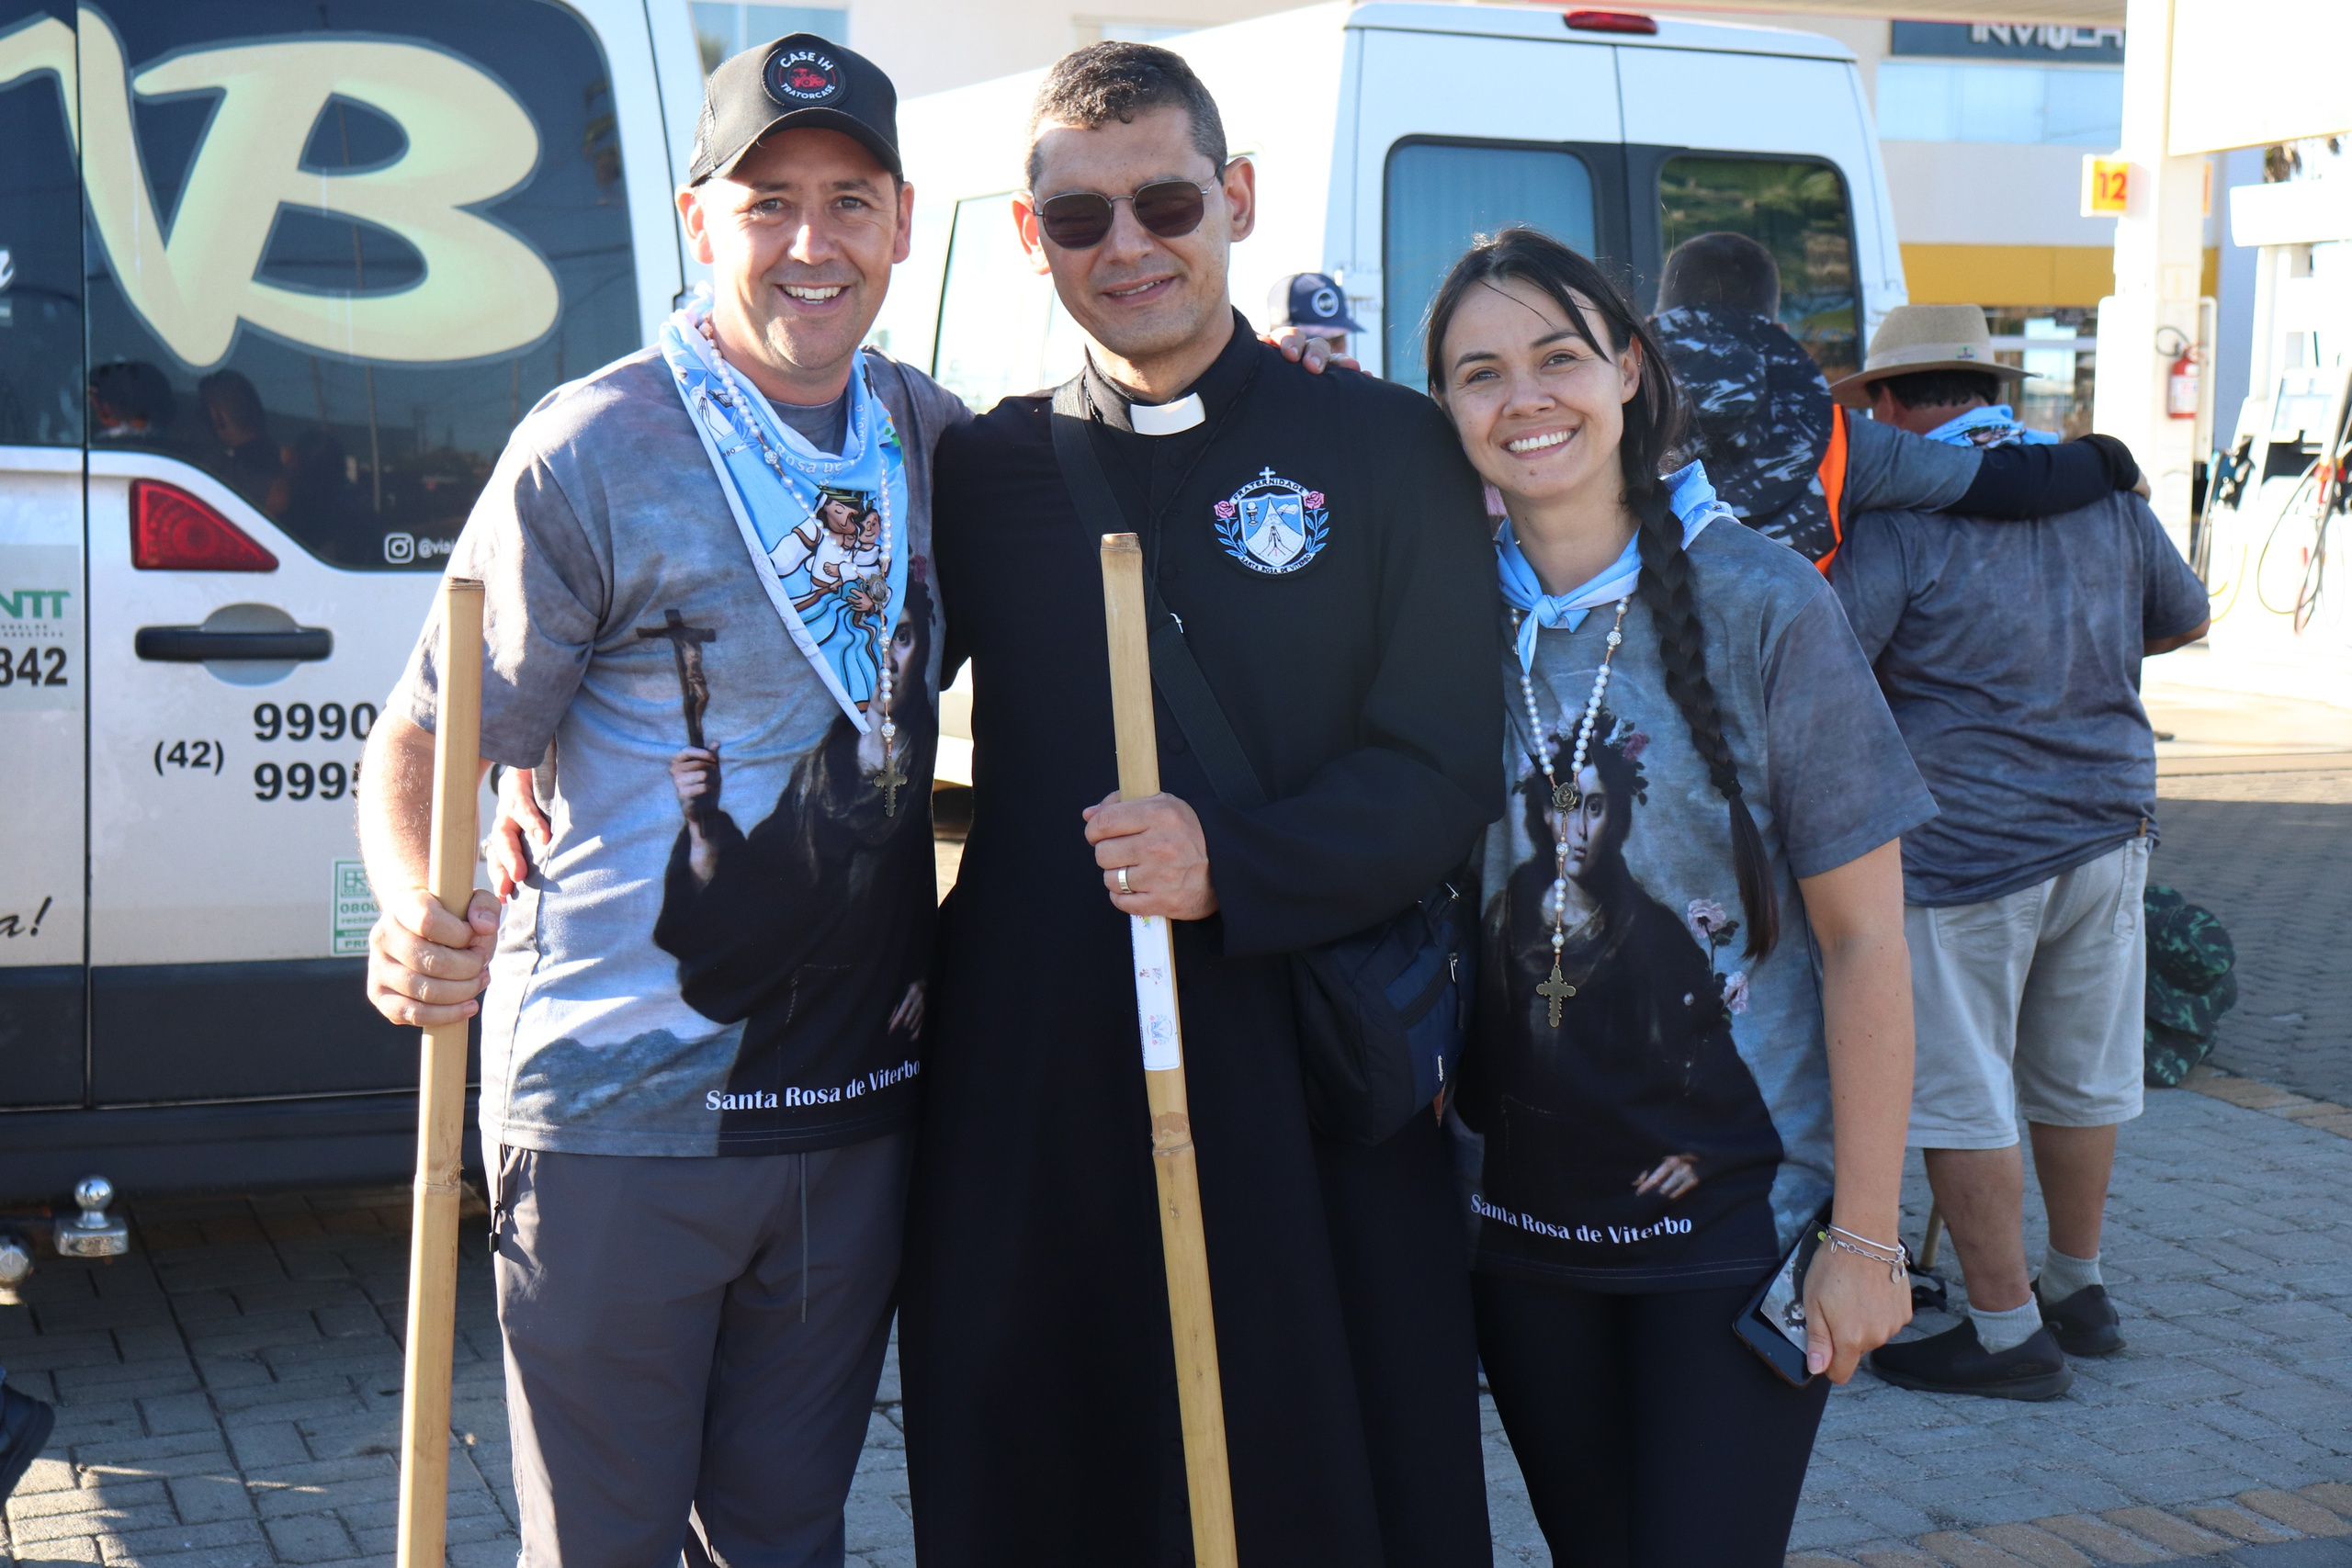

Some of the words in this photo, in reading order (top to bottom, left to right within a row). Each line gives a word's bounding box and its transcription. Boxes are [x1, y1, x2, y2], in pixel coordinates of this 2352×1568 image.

[780, 51, 816, 68] CASE
[817, 56, 834, 71] IH
[780, 82, 836, 99] TRATORCASE
[2099, 172, 2126, 200] 12
[1232, 479, 1306, 502] FRATERNIDADE
[1240, 556, 1260, 570] SANTA
[153, 740, 225, 776] (42)
[705, 1089, 779, 1111] Santa
[786, 1086, 842, 1108] Rosa
[845, 1078, 866, 1100] de
[868, 1059, 921, 1091] Viterbo
[1470, 1193, 1520, 1228] Santa
[1521, 1213, 1572, 1241] Rosa
[1576, 1224, 1603, 1244] de
[1607, 1215, 1693, 1245] Viterbo
